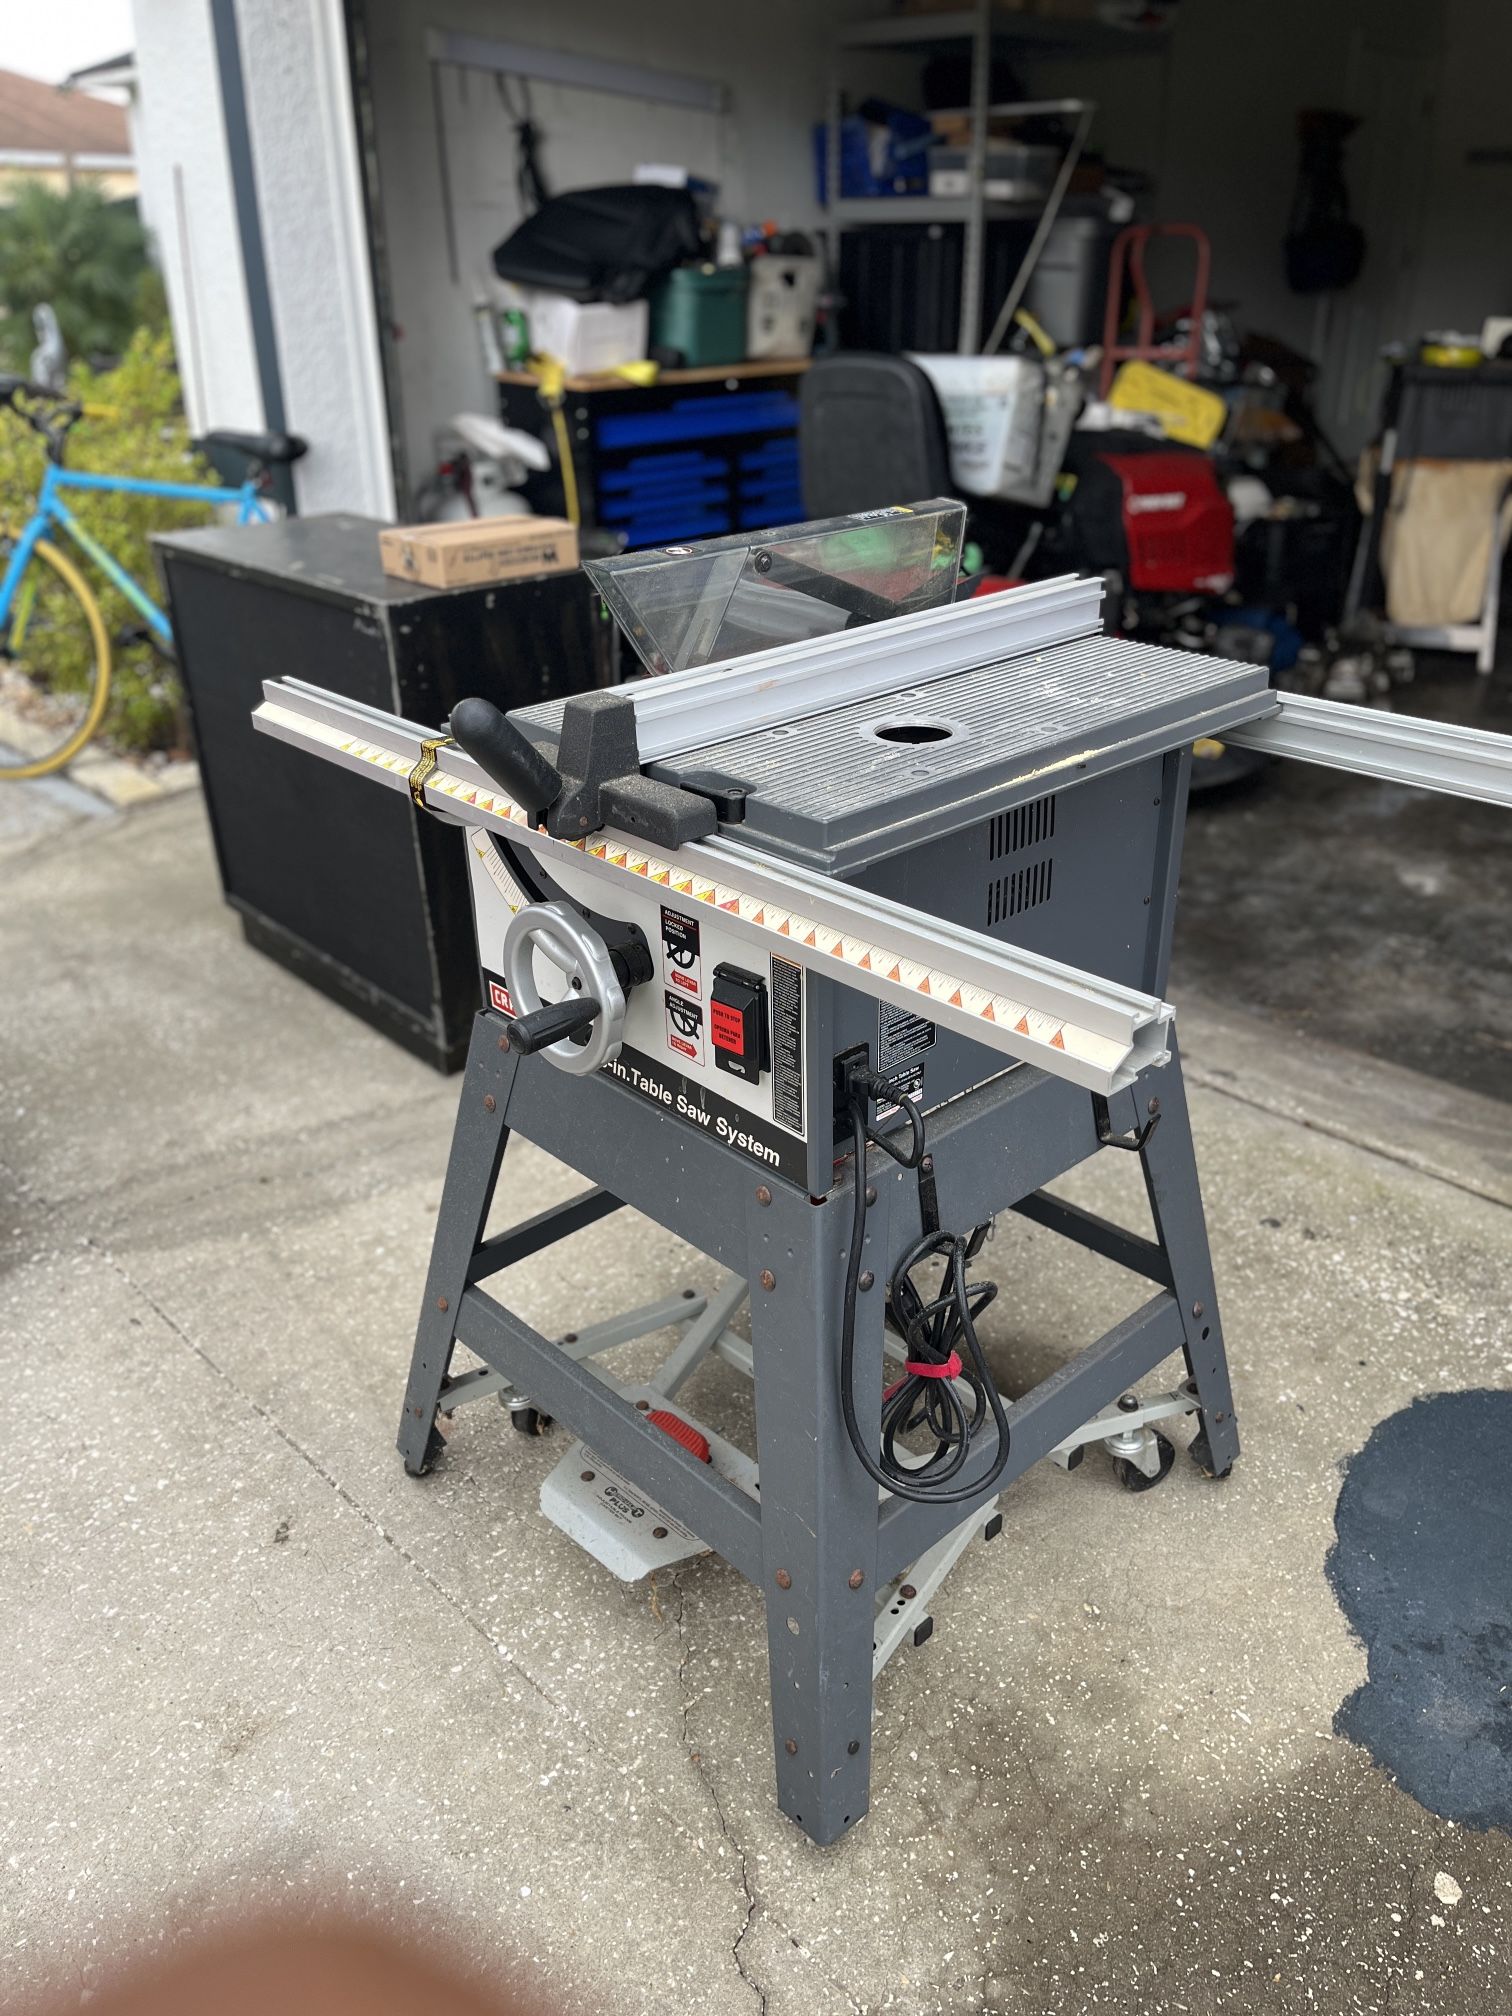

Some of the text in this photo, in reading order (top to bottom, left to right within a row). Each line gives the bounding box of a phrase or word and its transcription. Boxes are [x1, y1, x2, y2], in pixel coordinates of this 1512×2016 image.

[664, 909, 695, 927] ADJUSTMENT
[664, 919, 684, 931] LOCKED
[665, 926, 687, 940] POSITION
[669, 1002, 698, 1020] ADJUSTMENT
[676, 1094, 711, 1127] Saw
[715, 1116, 781, 1167] System
[609, 1497, 630, 1514] PLUS
